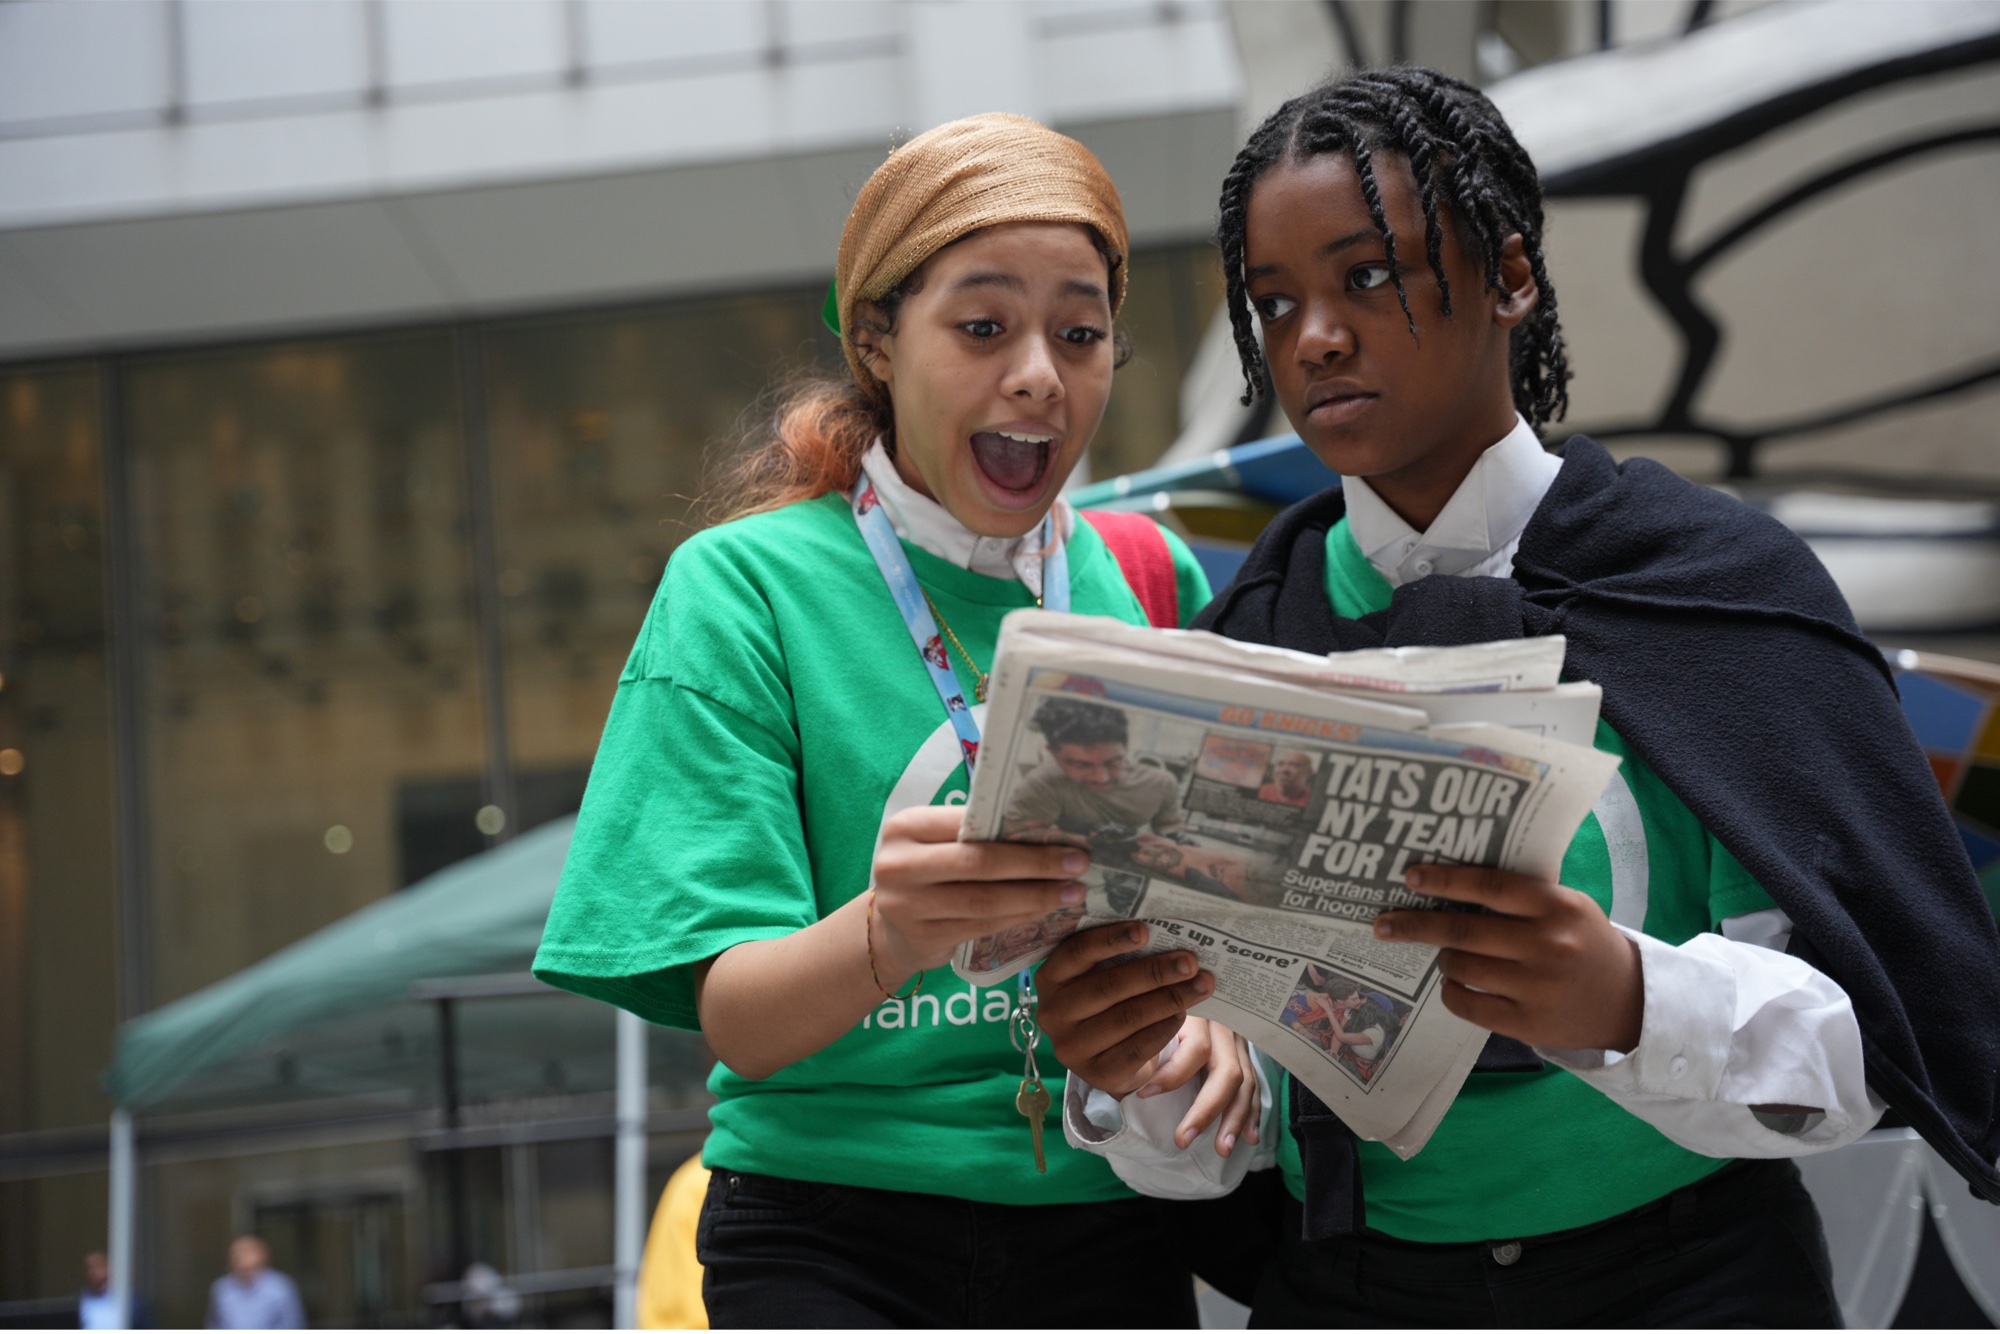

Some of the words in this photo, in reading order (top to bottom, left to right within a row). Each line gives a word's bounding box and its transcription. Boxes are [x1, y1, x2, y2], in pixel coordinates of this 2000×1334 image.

[1219, 705, 1256, 726] GO
[1259, 712, 1363, 744] KNICKS!
[1325, 753, 1426, 809] TATS
[1430, 766, 1519, 817] OUR
[1316, 800, 1380, 841] NY
[1384, 809, 1495, 864] TEAM
[1298, 833, 1384, 880] FOR
[1283, 889, 1314, 909] for
[1314, 896, 1381, 921] hoops
[1284, 868, 1385, 903] Superfans
[1388, 886, 1438, 912] think
[1188, 929, 1215, 947] up
[1340, 958, 1364, 970] Sports
[1343, 953, 1367, 965] Knicks
[1368, 962, 1404, 978] Coverage
